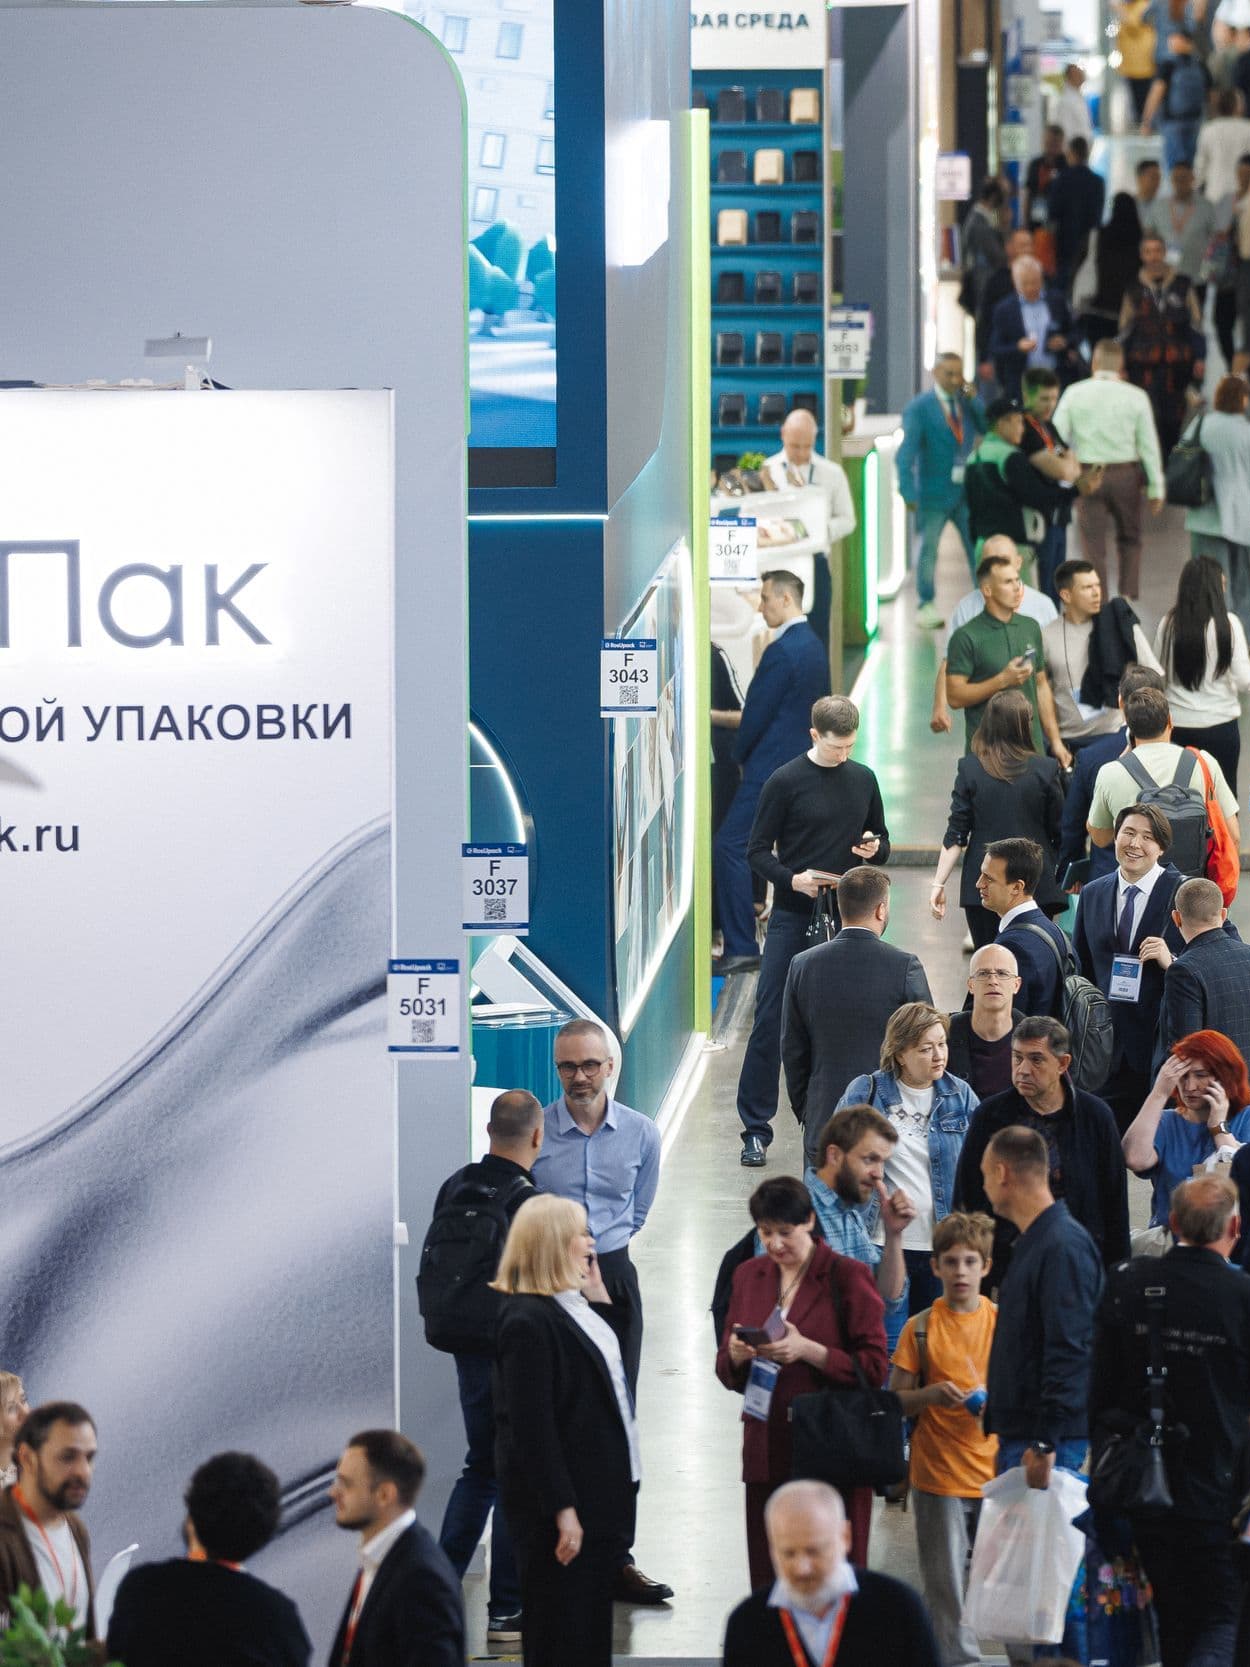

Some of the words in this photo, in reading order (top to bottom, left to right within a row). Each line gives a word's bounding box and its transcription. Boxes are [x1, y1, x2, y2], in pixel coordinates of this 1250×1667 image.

[735, 13, 809, 30] СРЕДА
[728, 529, 737, 541] F
[715, 544, 749, 556] 3047
[624, 653, 635, 666] F
[609, 669, 649, 683] 3043
[0, 697, 65, 742] ОЙ
[83, 703, 352, 742] УПАКОВКИ
[489, 860, 501, 876] F
[472, 879, 518, 895] 3037
[418, 978, 430, 995] F
[399, 998, 446, 1016] 5031
